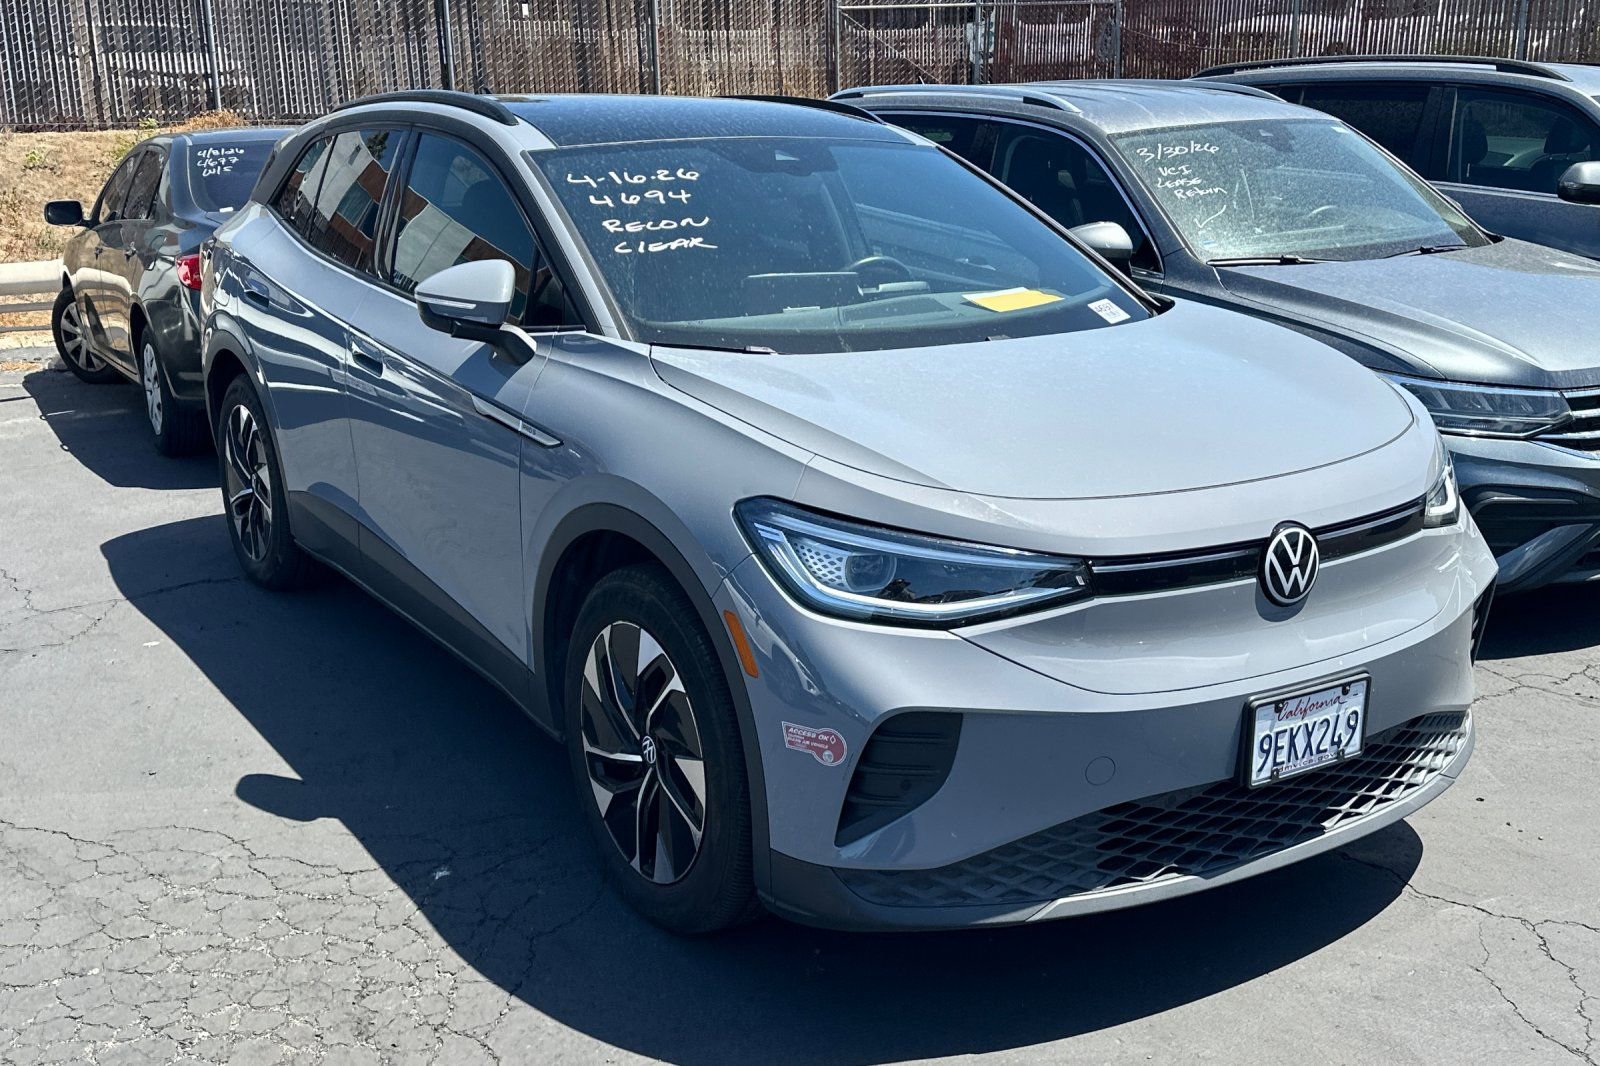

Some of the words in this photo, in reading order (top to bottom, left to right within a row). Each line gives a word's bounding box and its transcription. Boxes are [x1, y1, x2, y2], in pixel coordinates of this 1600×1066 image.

[1136, 140, 1220, 163] 3/30/26
[589, 189, 692, 207] 4694
[602, 216, 710, 233] RECON
[1265, 527, 1319, 603] VW
[1277, 695, 1348, 721] California
[788, 727, 817, 738] ACCESS
[1256, 709, 1359, 773] 9EKX249
